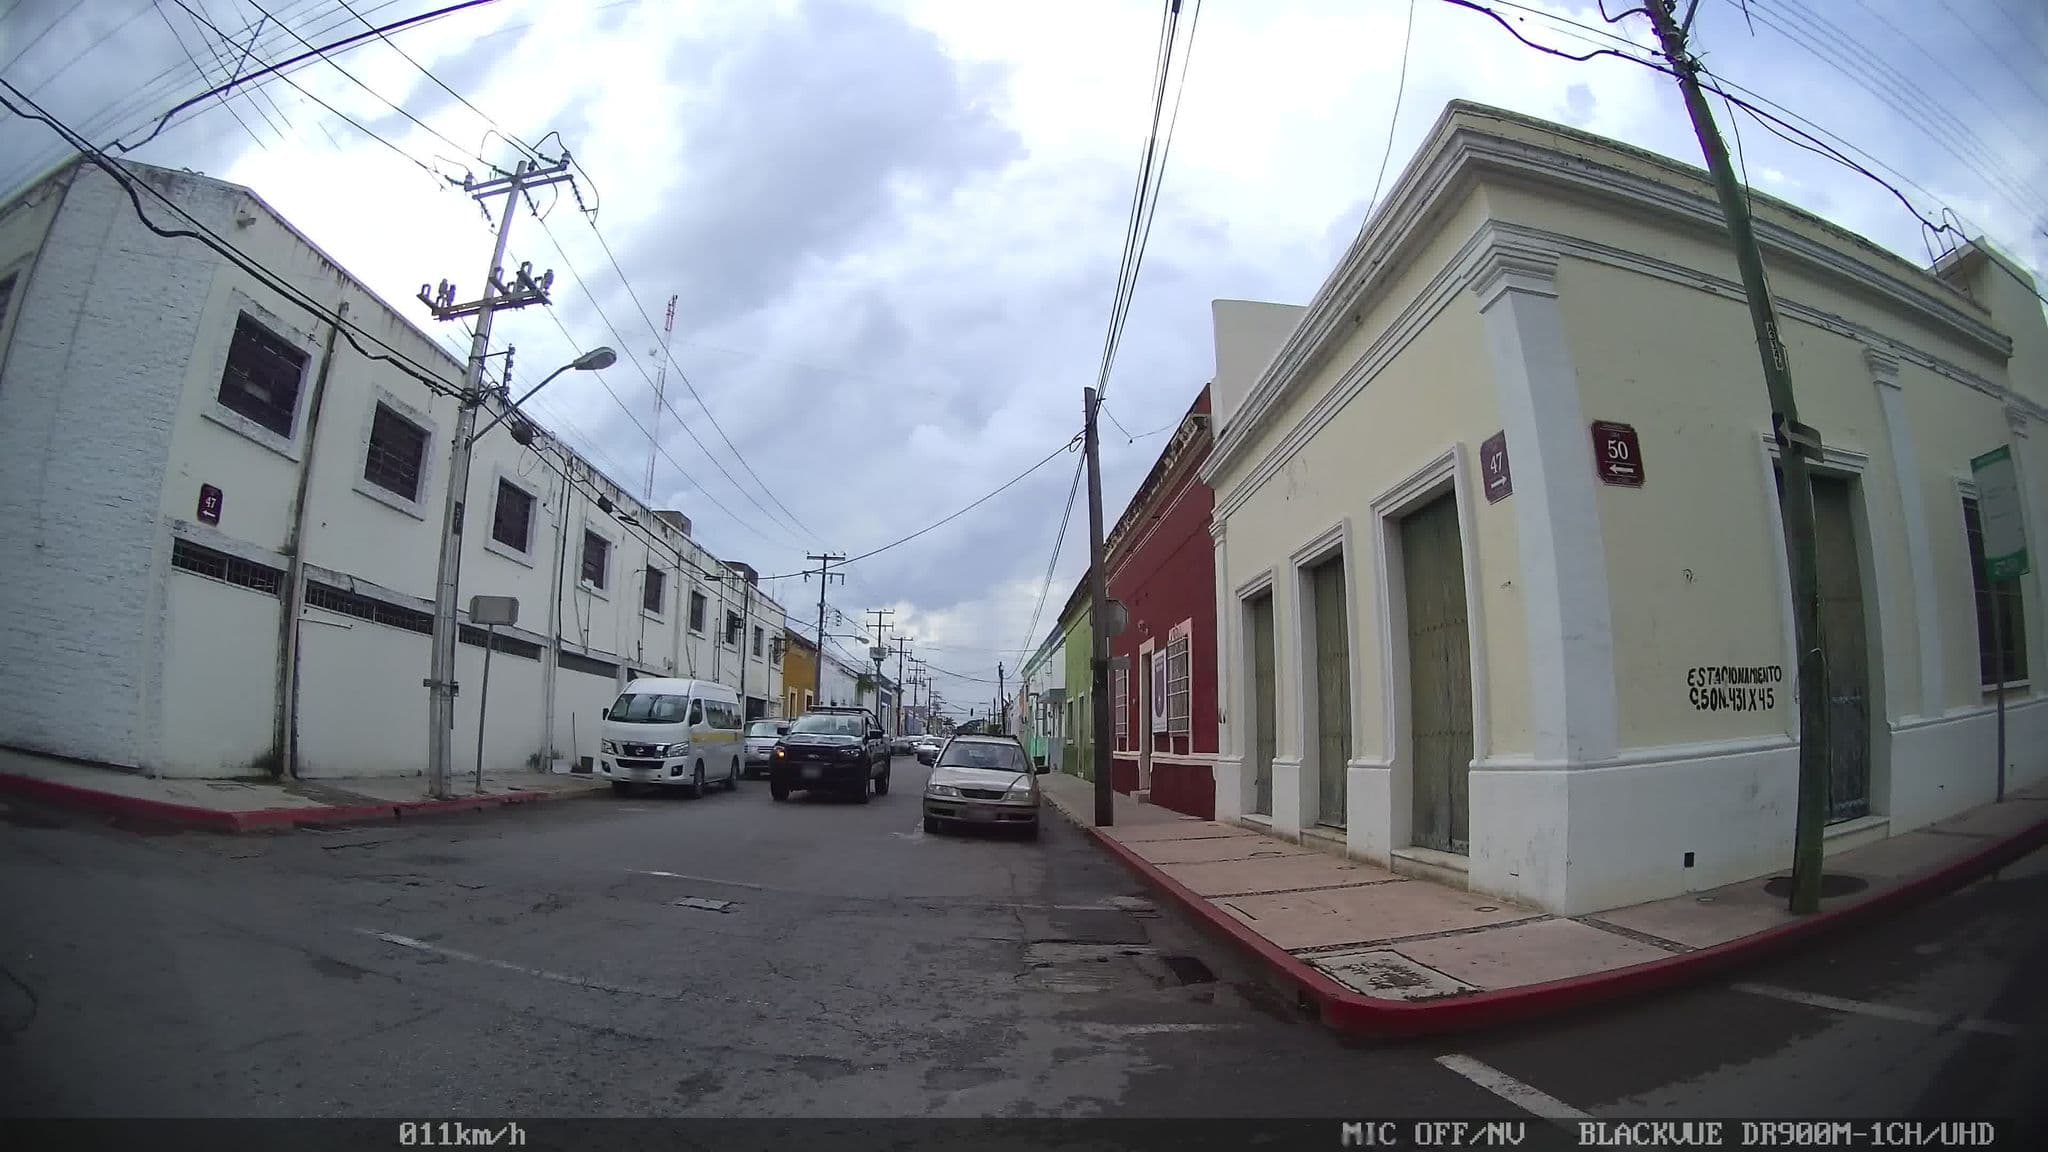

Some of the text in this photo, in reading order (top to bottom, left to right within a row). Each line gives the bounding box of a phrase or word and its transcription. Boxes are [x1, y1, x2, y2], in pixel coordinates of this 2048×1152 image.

[1607, 439, 1629, 460] 50
[1490, 451, 1503, 474] 47
[205, 496, 217, 509] 47
[1687, 665, 1782, 687] ESTACIONAMIENTO
